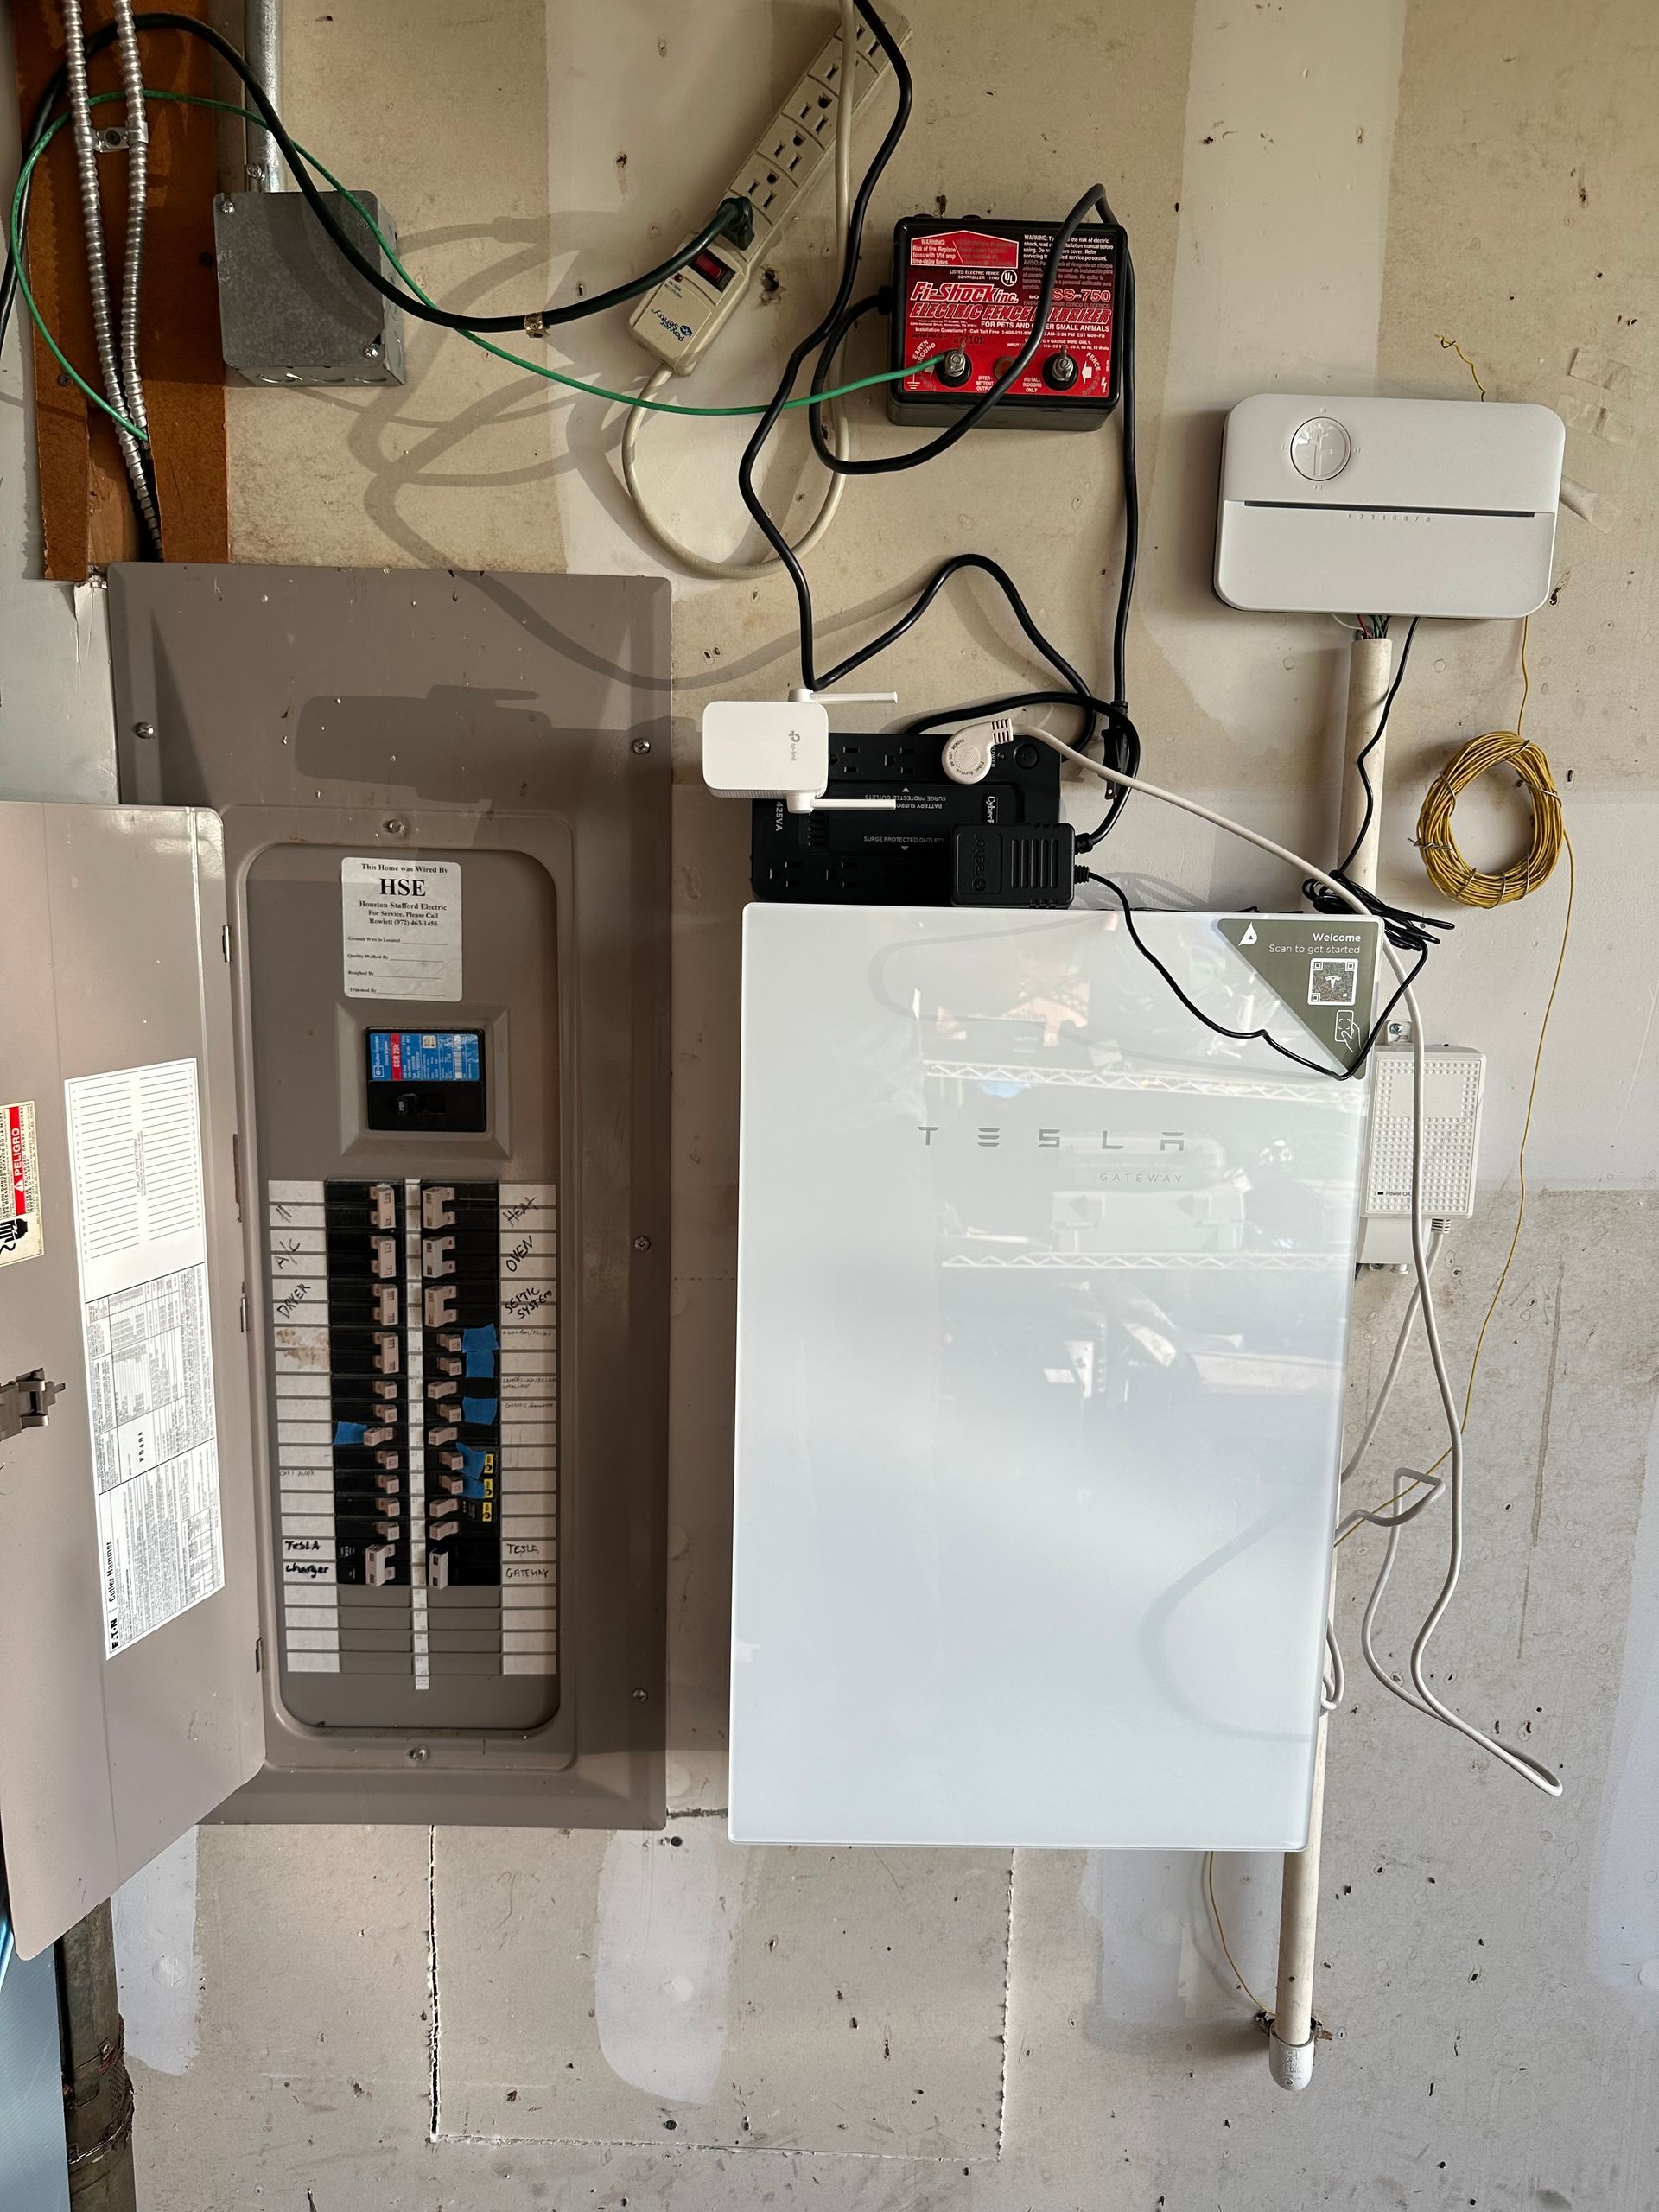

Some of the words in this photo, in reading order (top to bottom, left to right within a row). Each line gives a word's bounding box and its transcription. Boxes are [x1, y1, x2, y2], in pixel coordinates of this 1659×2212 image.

[910, 282, 998, 302] Fi-Shock
[1052, 288, 1111, 302] SS-750
[909, 302, 983, 320] ELECTRIC
[982, 304, 1032, 321] FENCE
[912, 340, 929, 359] EARTH
[1086, 352, 1101, 372] FENCE
[380, 878, 426, 897] HSE
[359, 900, 419, 910] Houston-Stafford
[1313, 932, 1361, 942] Welcome
[1269, 944, 1293, 953] Scan
[1307, 946, 1323, 955] get
[918, 1127, 1184, 1151] TESLA
[11, 1128, 22, 1177] PELIGRO
[1100, 1173, 1182, 1183] GATEWAY
[502, 1196, 537, 1228] HEAT
[274, 1238, 301, 1270] A/C
[505, 1235, 533, 1272] OVEN
[276, 1283, 311, 1319] DRYER
[505, 1287, 540, 1314] SEPTIC
[518, 1290, 552, 1320] SYSTEM
[506, 1543, 539, 1554] TESLA
[505, 1567, 549, 1579] GATEWAY
